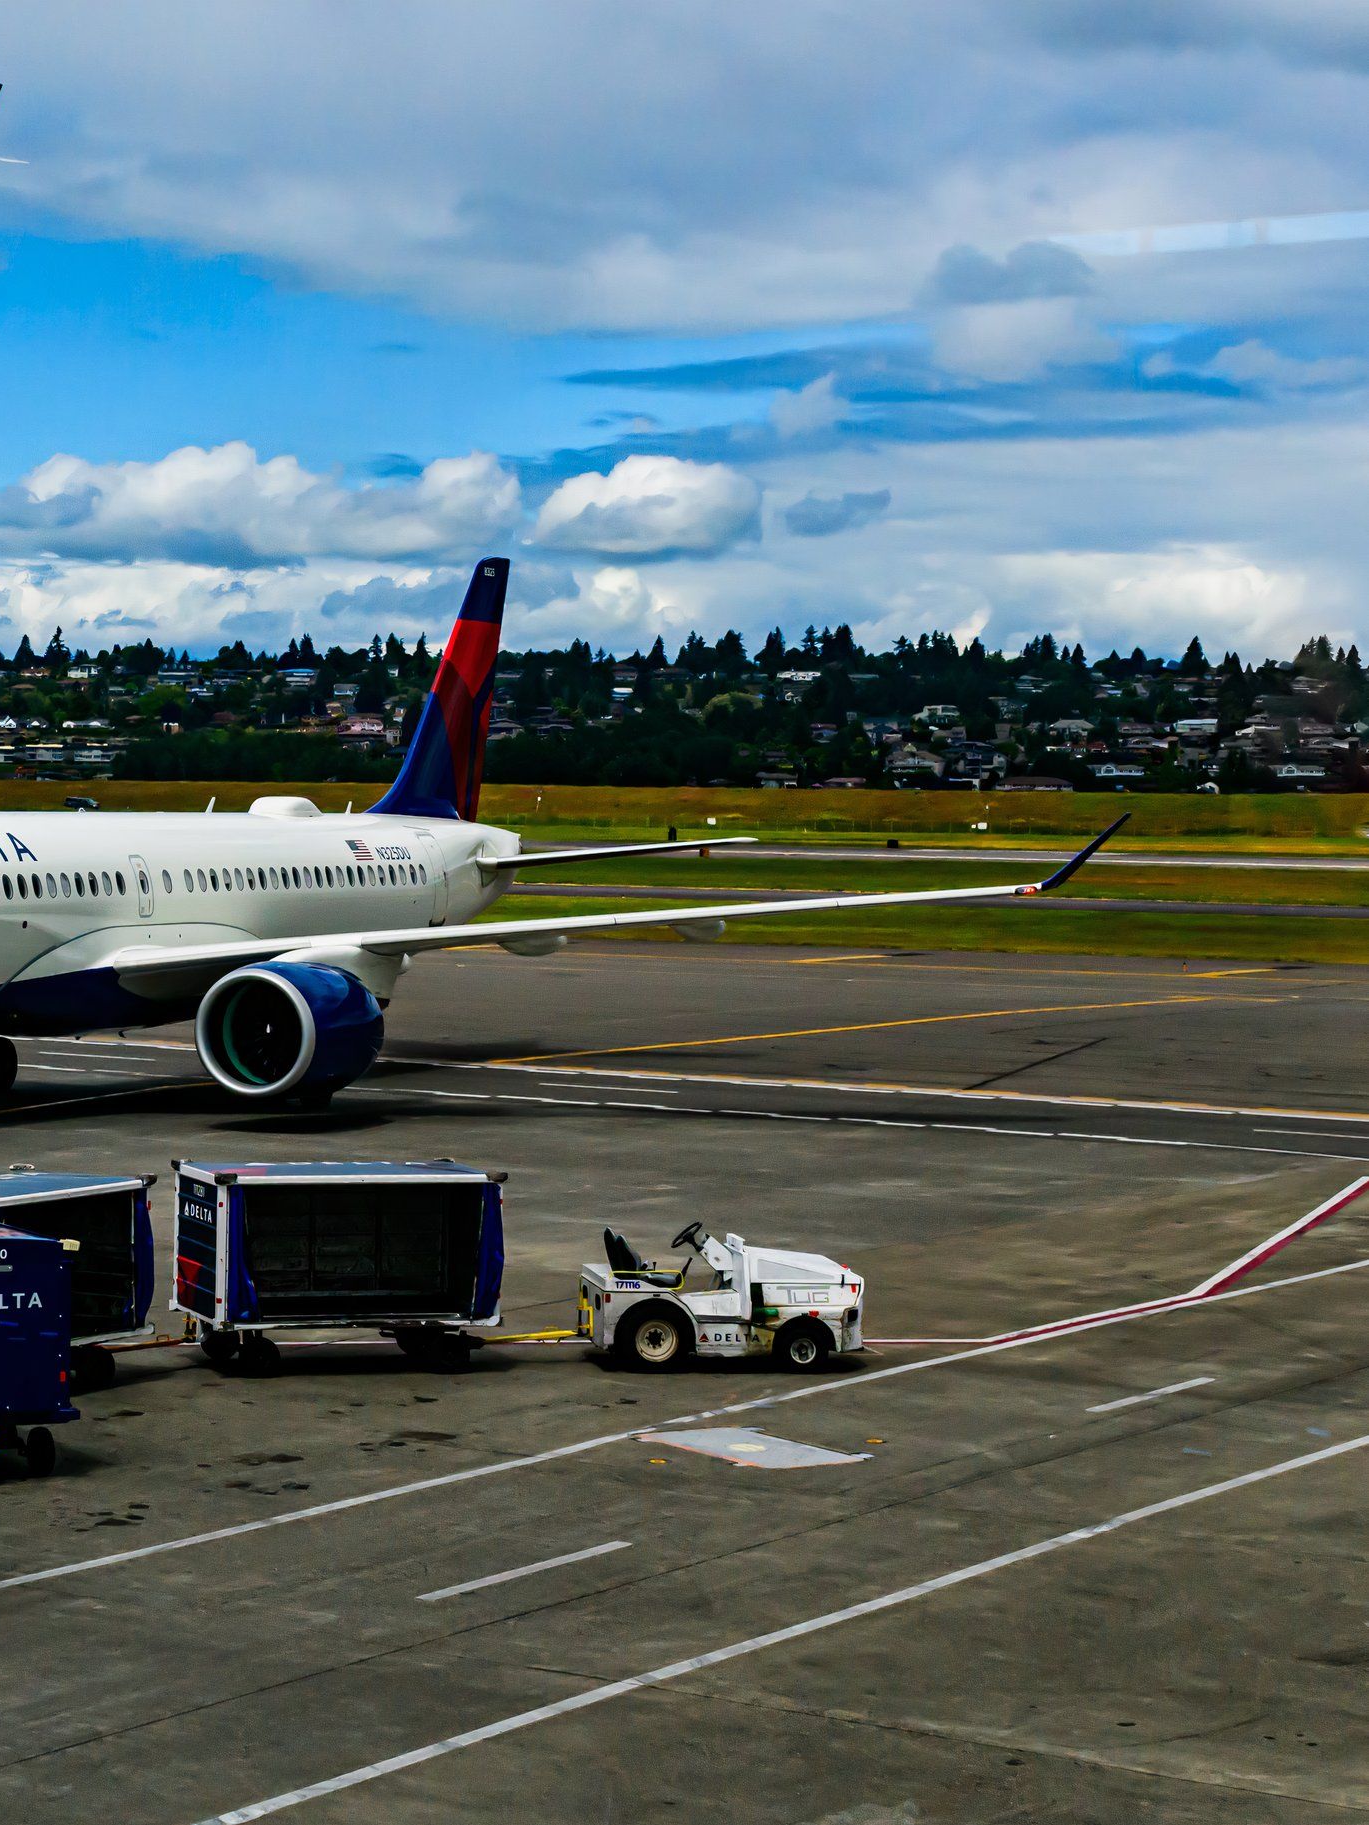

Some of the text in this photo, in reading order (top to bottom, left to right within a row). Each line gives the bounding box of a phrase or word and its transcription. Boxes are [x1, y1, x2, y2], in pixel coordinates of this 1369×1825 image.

[374, 846, 412, 861] N325DU
[190, 1203, 212, 1224] DELTA
[776, 1285, 830, 1304] TUG
[714, 1332, 760, 1343] DELTA
